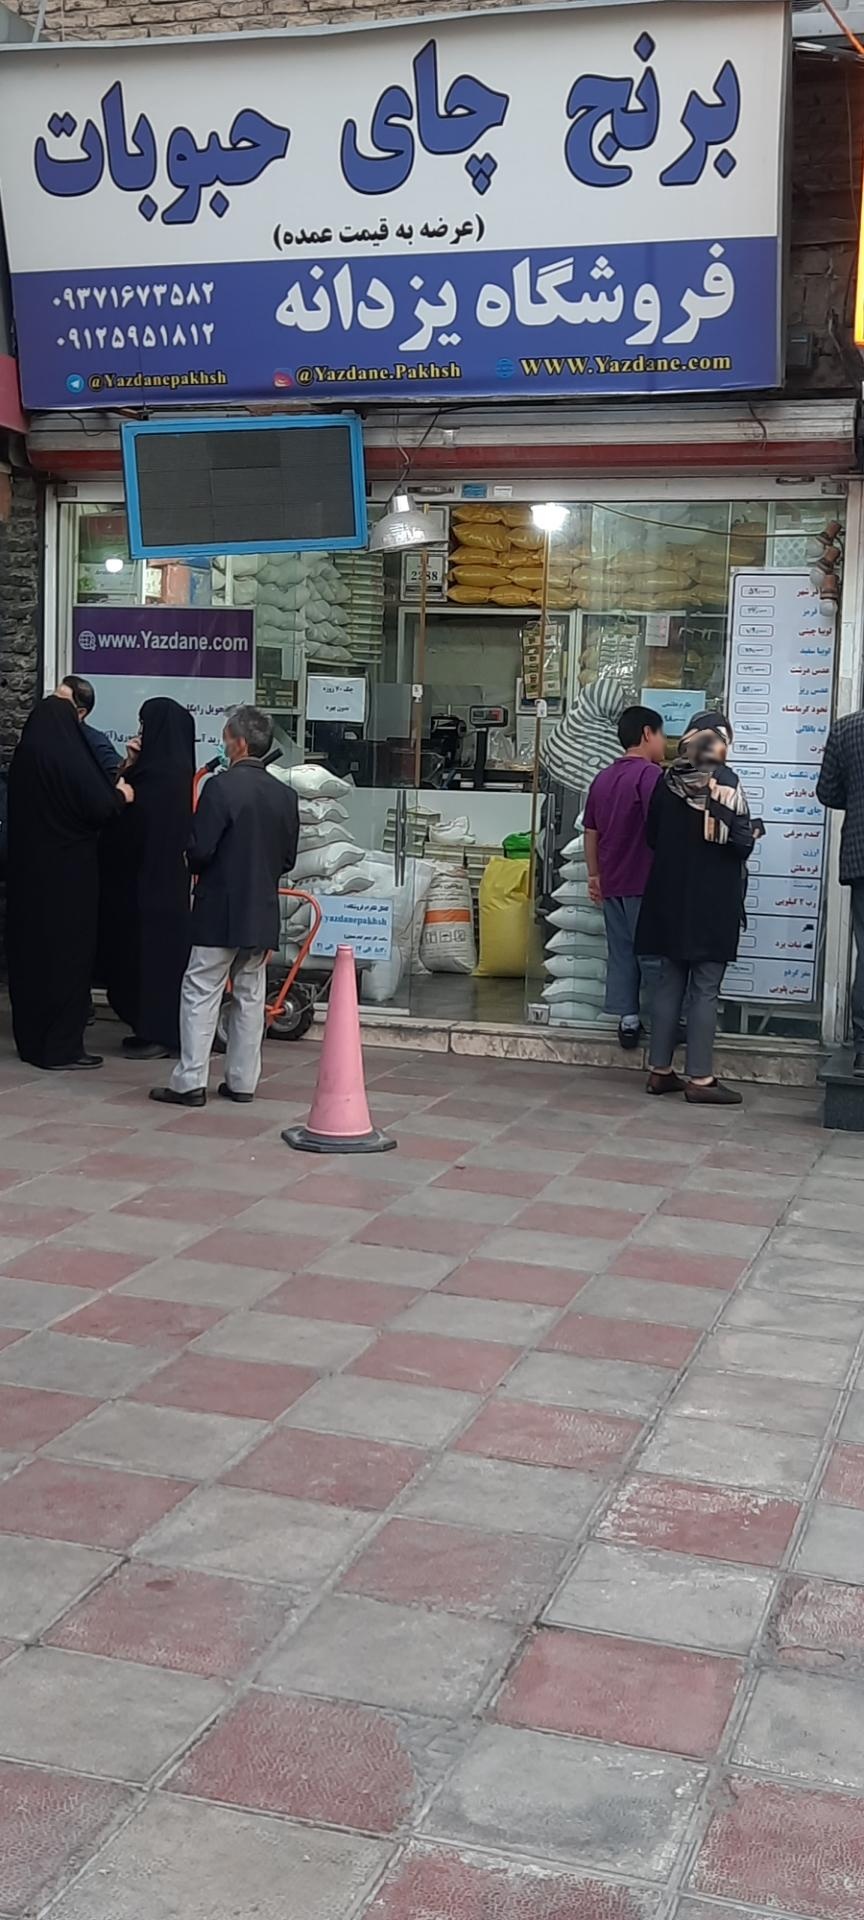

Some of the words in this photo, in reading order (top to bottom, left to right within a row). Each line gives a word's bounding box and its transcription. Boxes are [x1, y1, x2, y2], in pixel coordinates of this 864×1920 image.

[340, 39, 510, 195] چای
[565, 31, 741, 188] برنج
[34, 80, 291, 225] حبوبات
[273, 224, 333, 250] عمده)
[338, 218, 389, 246] قیمت
[395, 222, 413, 245] به
[420, 214, 485, 245] (عرضه
[53, 281, 214, 310] ۰۹۳۷۱۶۷۳۵۸۲
[275, 263, 462, 351] یزدانه
[476, 242, 735, 346] فروشگاه
[56, 322, 214, 350] ۰۹۱۲۵۹۵۱۸۱۲
[297, 363, 461, 385] @Yazdane.Pakhsh
[520, 355, 732, 376] WWW.Yazdane.com
[89, 370, 227, 390] @Yazdanepakhsh
[97, 630, 249, 651] www.Yazdane.com
